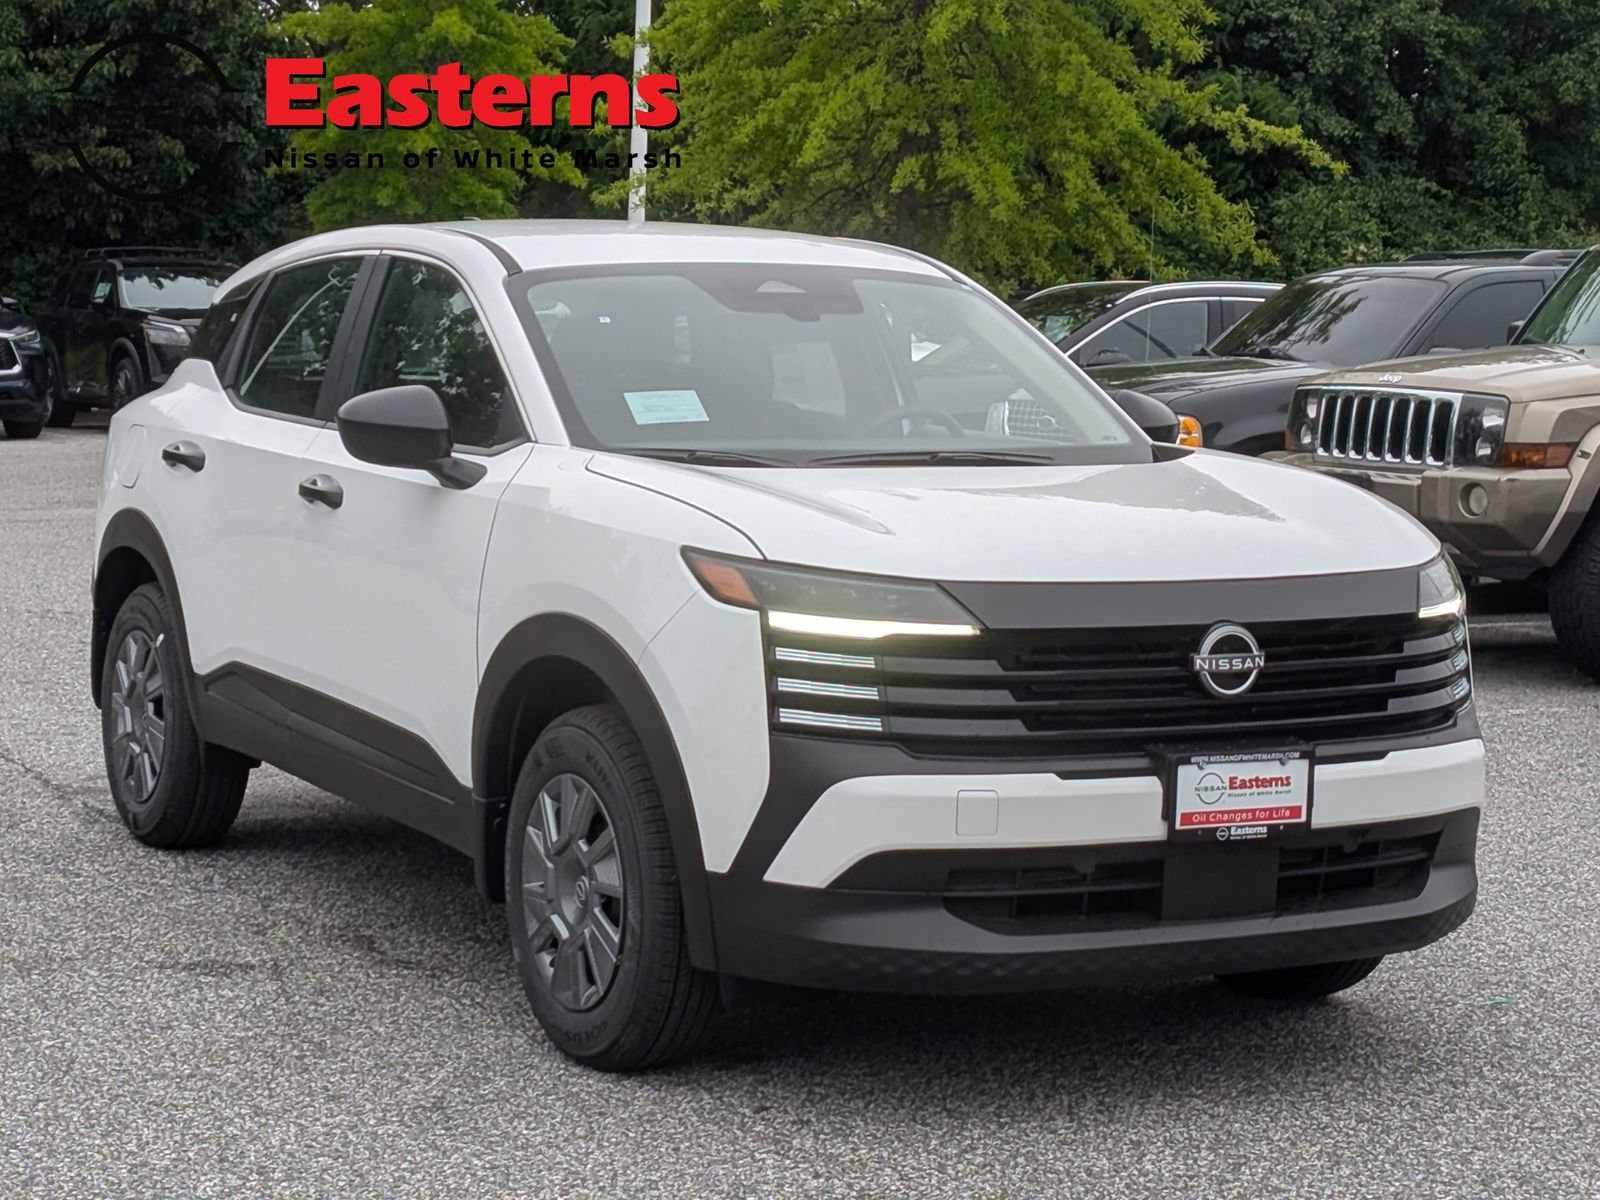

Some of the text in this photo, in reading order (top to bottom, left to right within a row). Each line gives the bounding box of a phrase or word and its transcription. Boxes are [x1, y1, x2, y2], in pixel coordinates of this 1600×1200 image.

[1196, 656, 1265, 670] NISSAN
[1194, 785, 1228, 793] NISSAN
[1228, 775, 1291, 790] Easterns
[1192, 808, 1291, 822] Oil Changes for Life
[1230, 826, 1268, 835] Easterns
